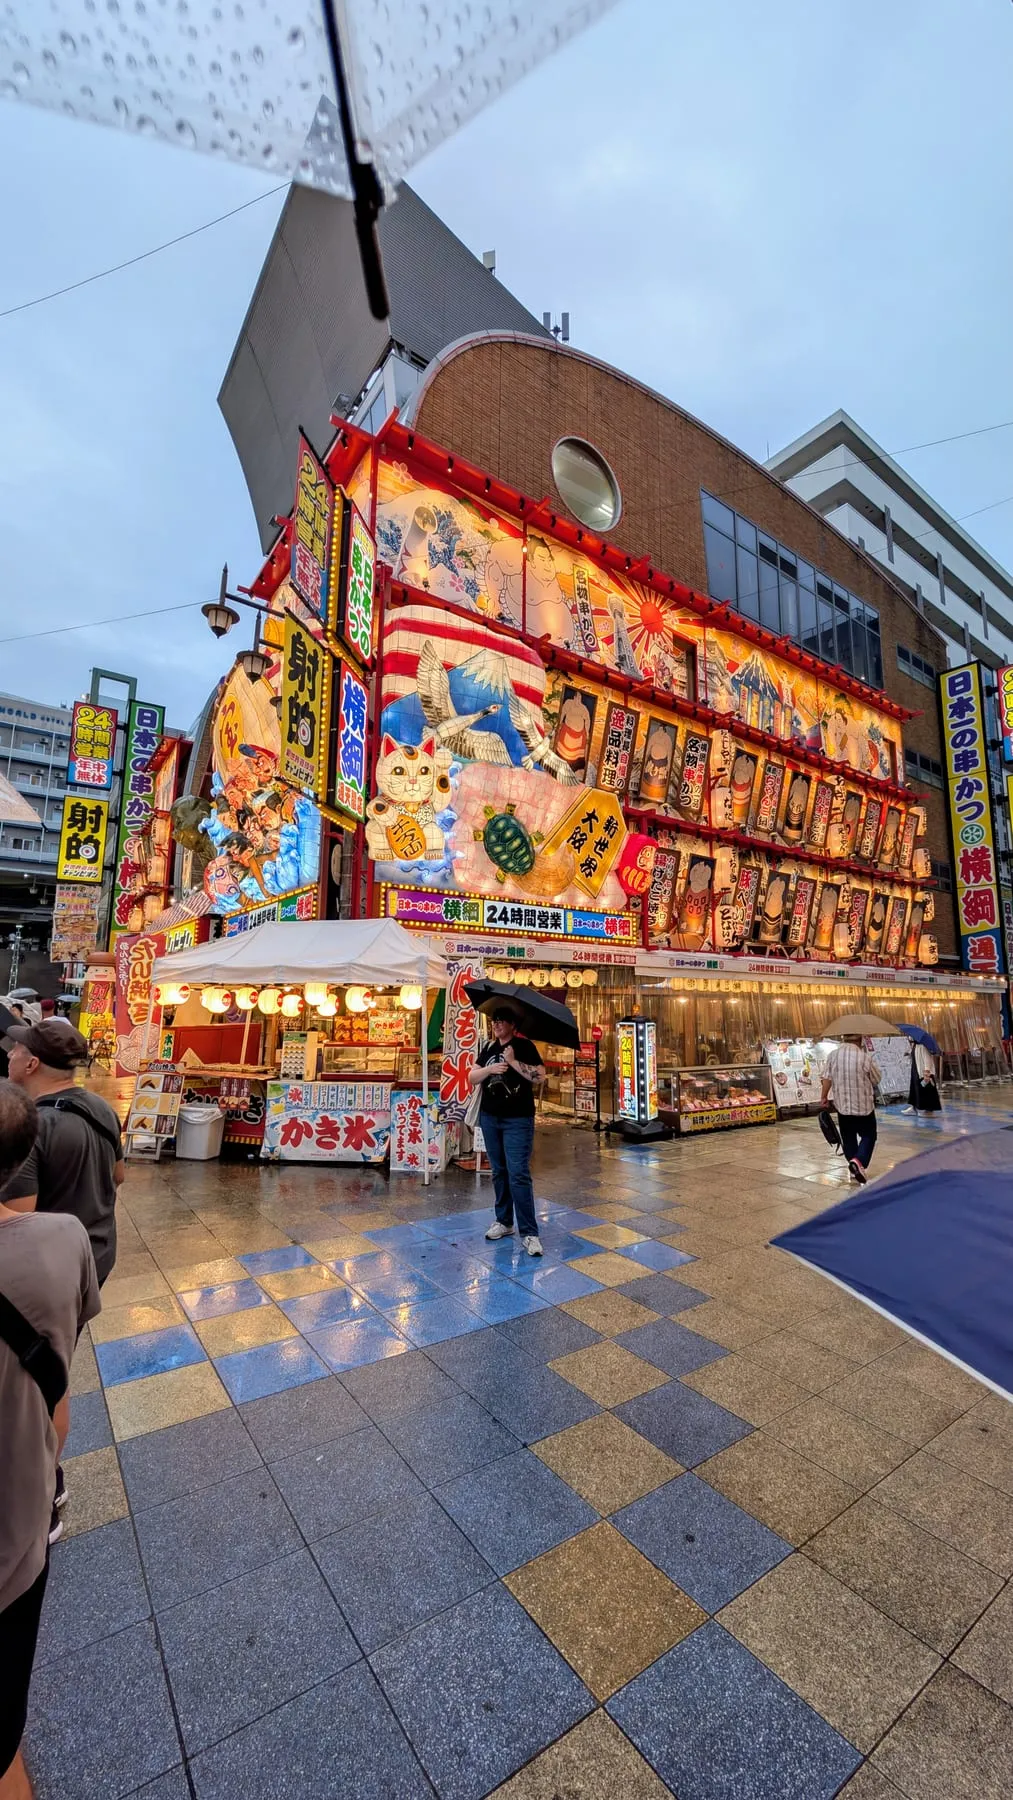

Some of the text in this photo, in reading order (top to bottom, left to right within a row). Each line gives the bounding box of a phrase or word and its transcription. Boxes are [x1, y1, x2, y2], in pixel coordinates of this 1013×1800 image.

[301, 452, 332, 518] 24
[348, 541, 363, 643] 串かつ
[360, 557, 373, 657] 日本一の
[77, 707, 113, 730] 24
[288, 632, 319, 758] 射的
[74, 741, 109, 760] 営業
[76, 727, 111, 746] 時間
[341, 672, 367, 793] 横綱
[601, 708, 625, 787] 逸品料理
[616, 712, 635, 789] 料理長自慢の
[948, 670, 986, 822] 日本一の串かつ
[75, 770, 106, 784] 無休
[77, 758, 107, 773] 年中
[679, 736, 701, 807] 名物串かつ
[66, 801, 104, 864] 射的
[566, 808, 599, 854] 大阪
[579, 815, 619, 878] 新世界
[959, 845, 997, 928] 横綱
[397, 898, 442, 914] 日本一の串かつ
[442, 898, 481, 923] 横綱
[486, 904, 563, 931] 24時間営業
[604, 916, 632, 937] 横綱
[456, 943, 505, 955] 日本一の串かつ
[572, 951, 613, 963] 24時間営業
[131, 939, 157, 1025] たい焼き
[183, 1088, 264, 1124] たいき
[279, 1115, 376, 1151] かき氷
[396, 1102, 407, 1162] やってます
[407, 1095, 423, 1145] かき氷
[407, 1152, 420, 1167] 氷
